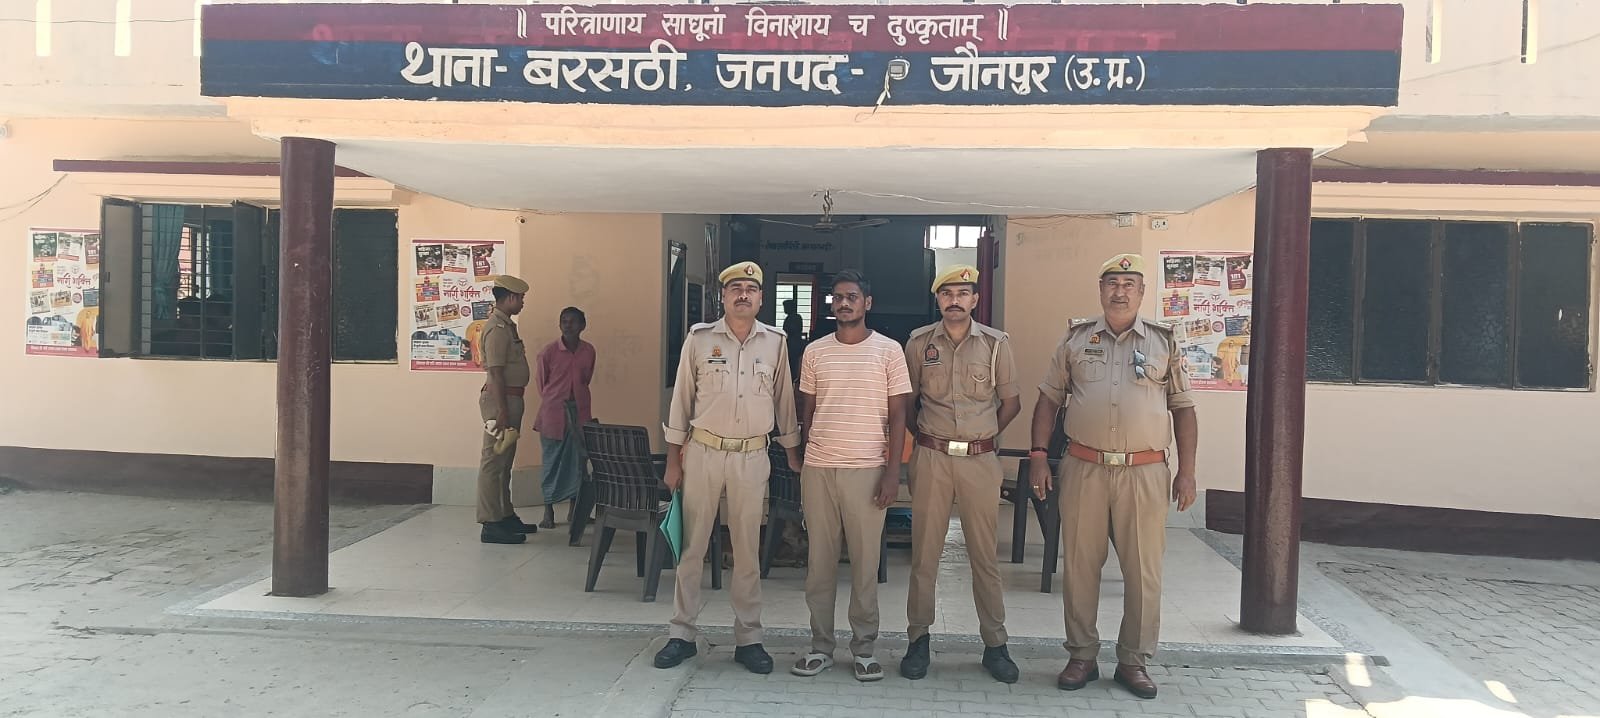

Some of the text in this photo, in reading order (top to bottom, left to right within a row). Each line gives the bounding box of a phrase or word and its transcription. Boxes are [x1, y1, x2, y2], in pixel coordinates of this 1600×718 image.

[540, 6, 647, 36] परित्राणाय
[661, 7, 726, 41] साधूनां
[744, 6, 833, 40] विनाशाय
[848, 14, 876, 37] च
[887, 13, 985, 46] दुष्कृताम्
[930, 42, 1058, 97] जौनपुर
